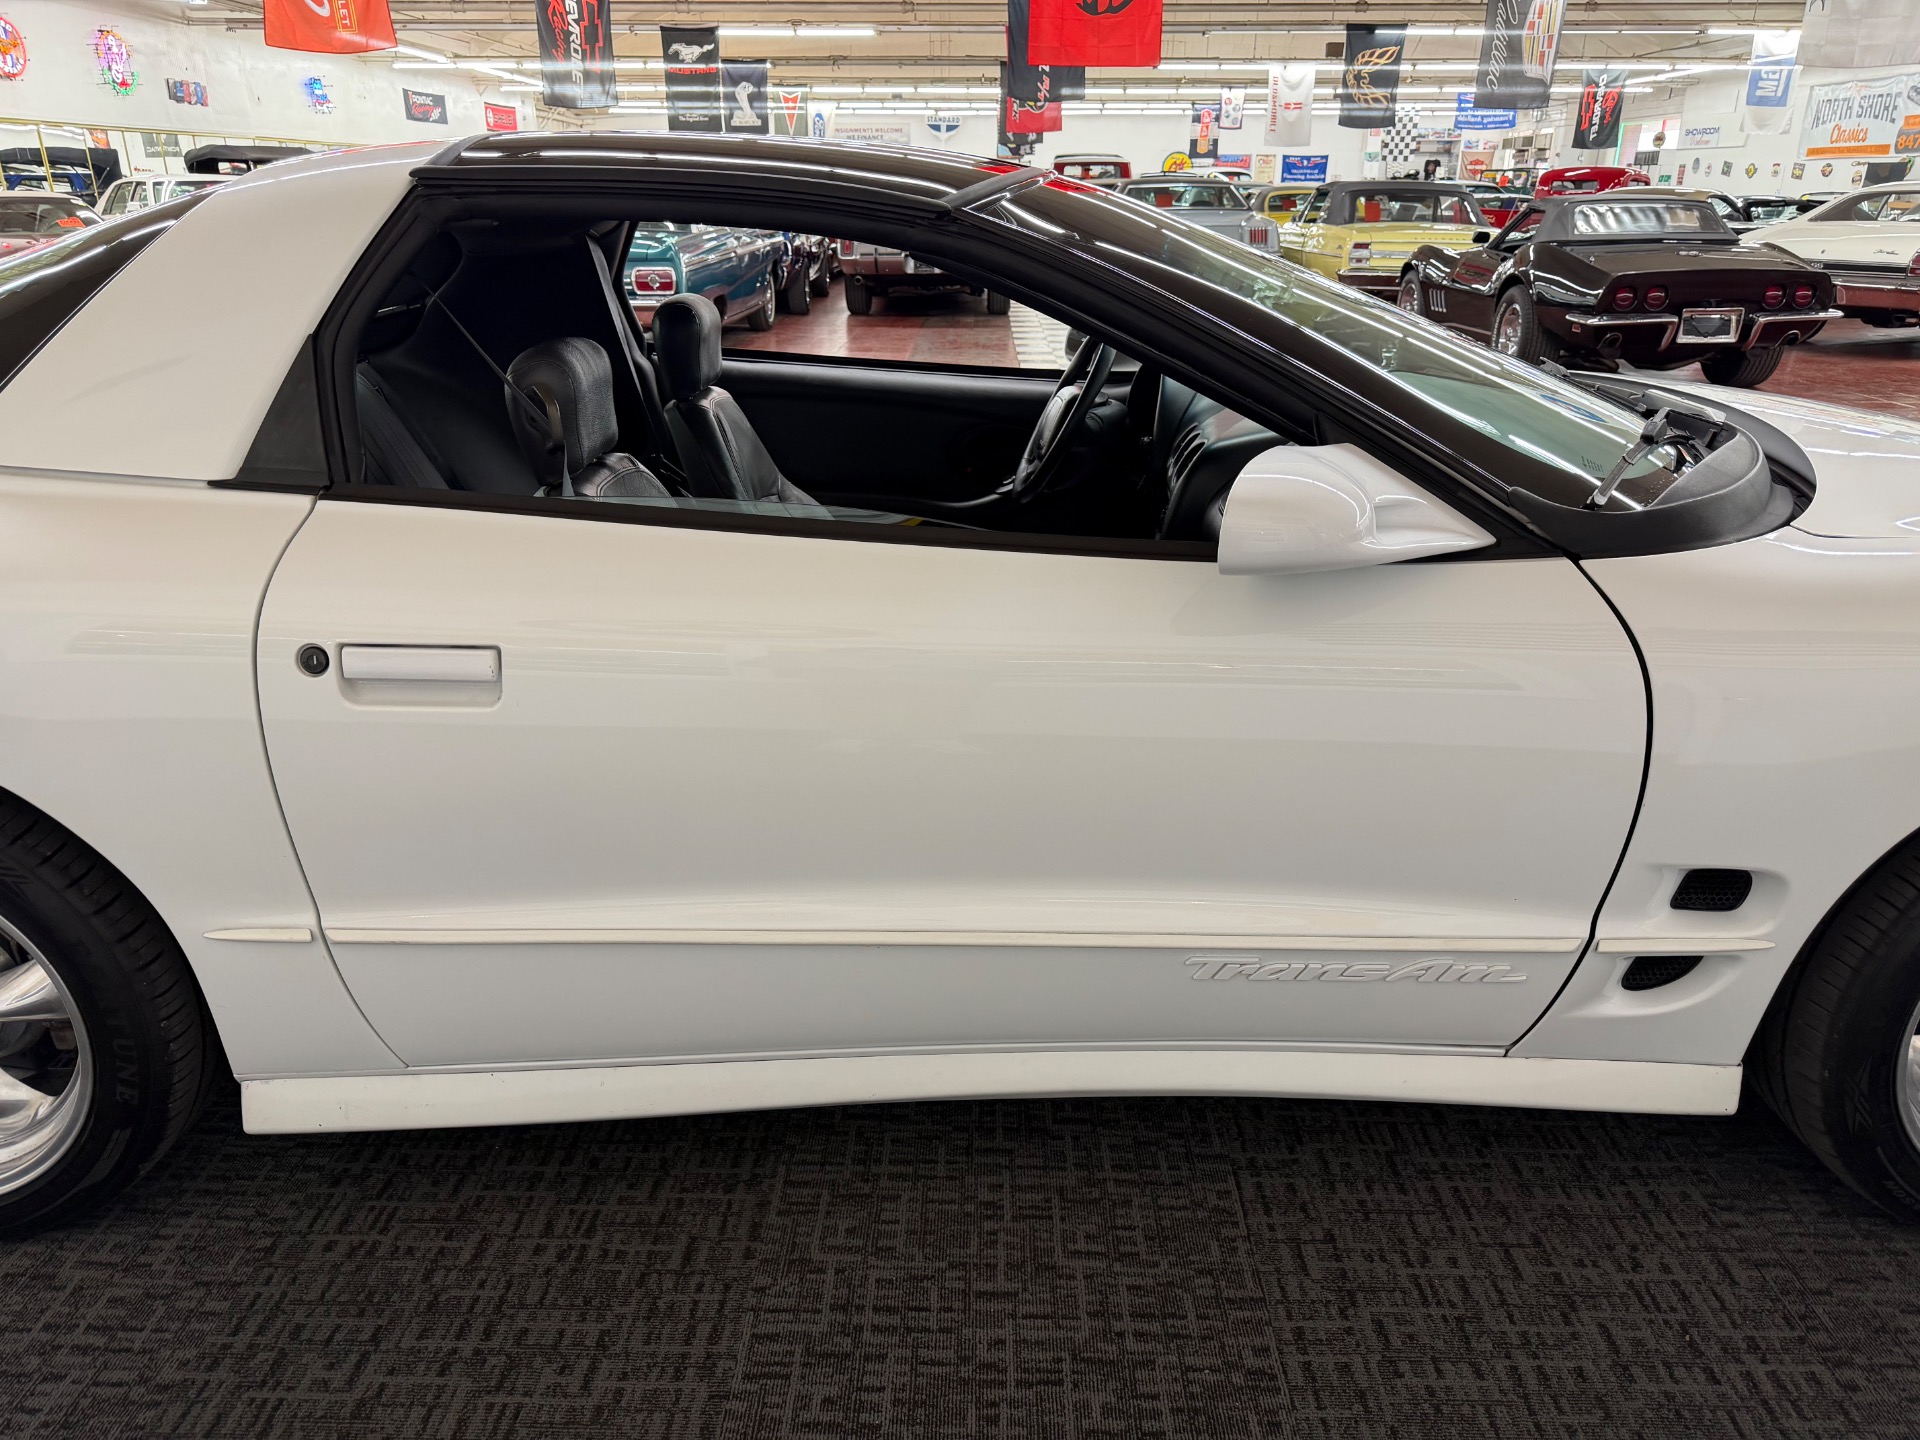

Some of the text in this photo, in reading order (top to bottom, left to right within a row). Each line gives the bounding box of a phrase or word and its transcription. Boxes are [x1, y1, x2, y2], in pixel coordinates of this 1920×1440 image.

[667, 66, 717, 75] MUSTANG
[412, 95, 433, 105] PONTIAC
[1269, 76, 1279, 132] OLDSMOBILE
[1811, 91, 1903, 130] NORTH SHORE
[1684, 127, 1720, 137] SHOWROOM
[1829, 122, 1869, 144] Classics
[1896, 134, 1920, 150] 847
